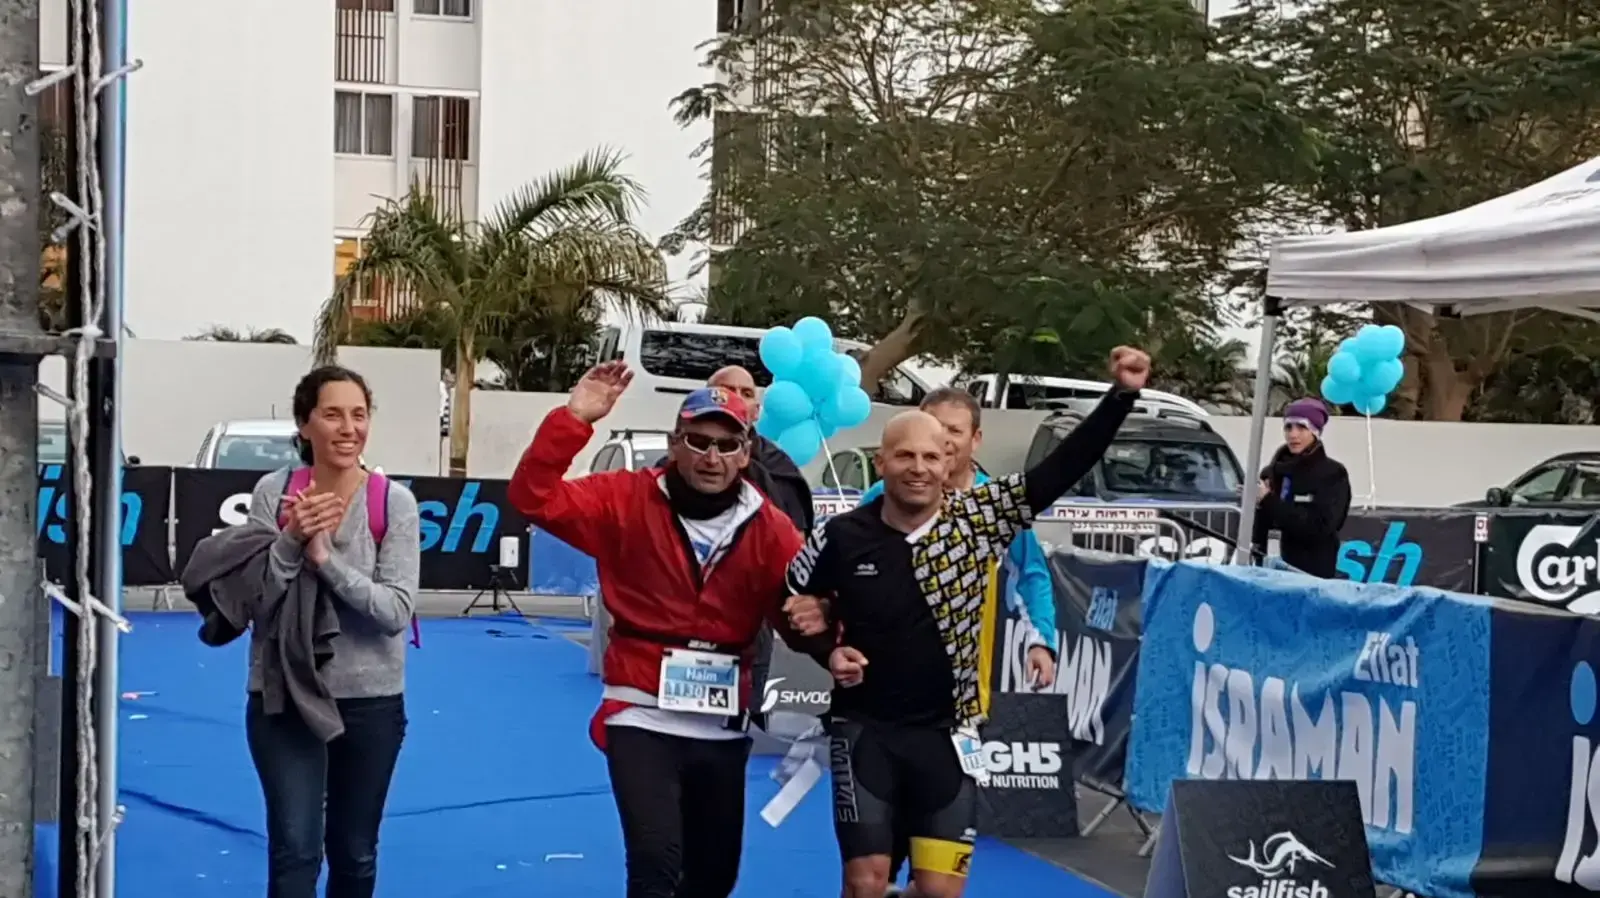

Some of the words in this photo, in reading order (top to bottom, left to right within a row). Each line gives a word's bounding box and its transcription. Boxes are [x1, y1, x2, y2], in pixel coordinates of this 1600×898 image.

[789, 526, 828, 587] BIKE
[1516, 524, 1600, 601] Car
[1354, 630, 1419, 688] Eilat
[992, 774, 1059, 789] NUTRITION
